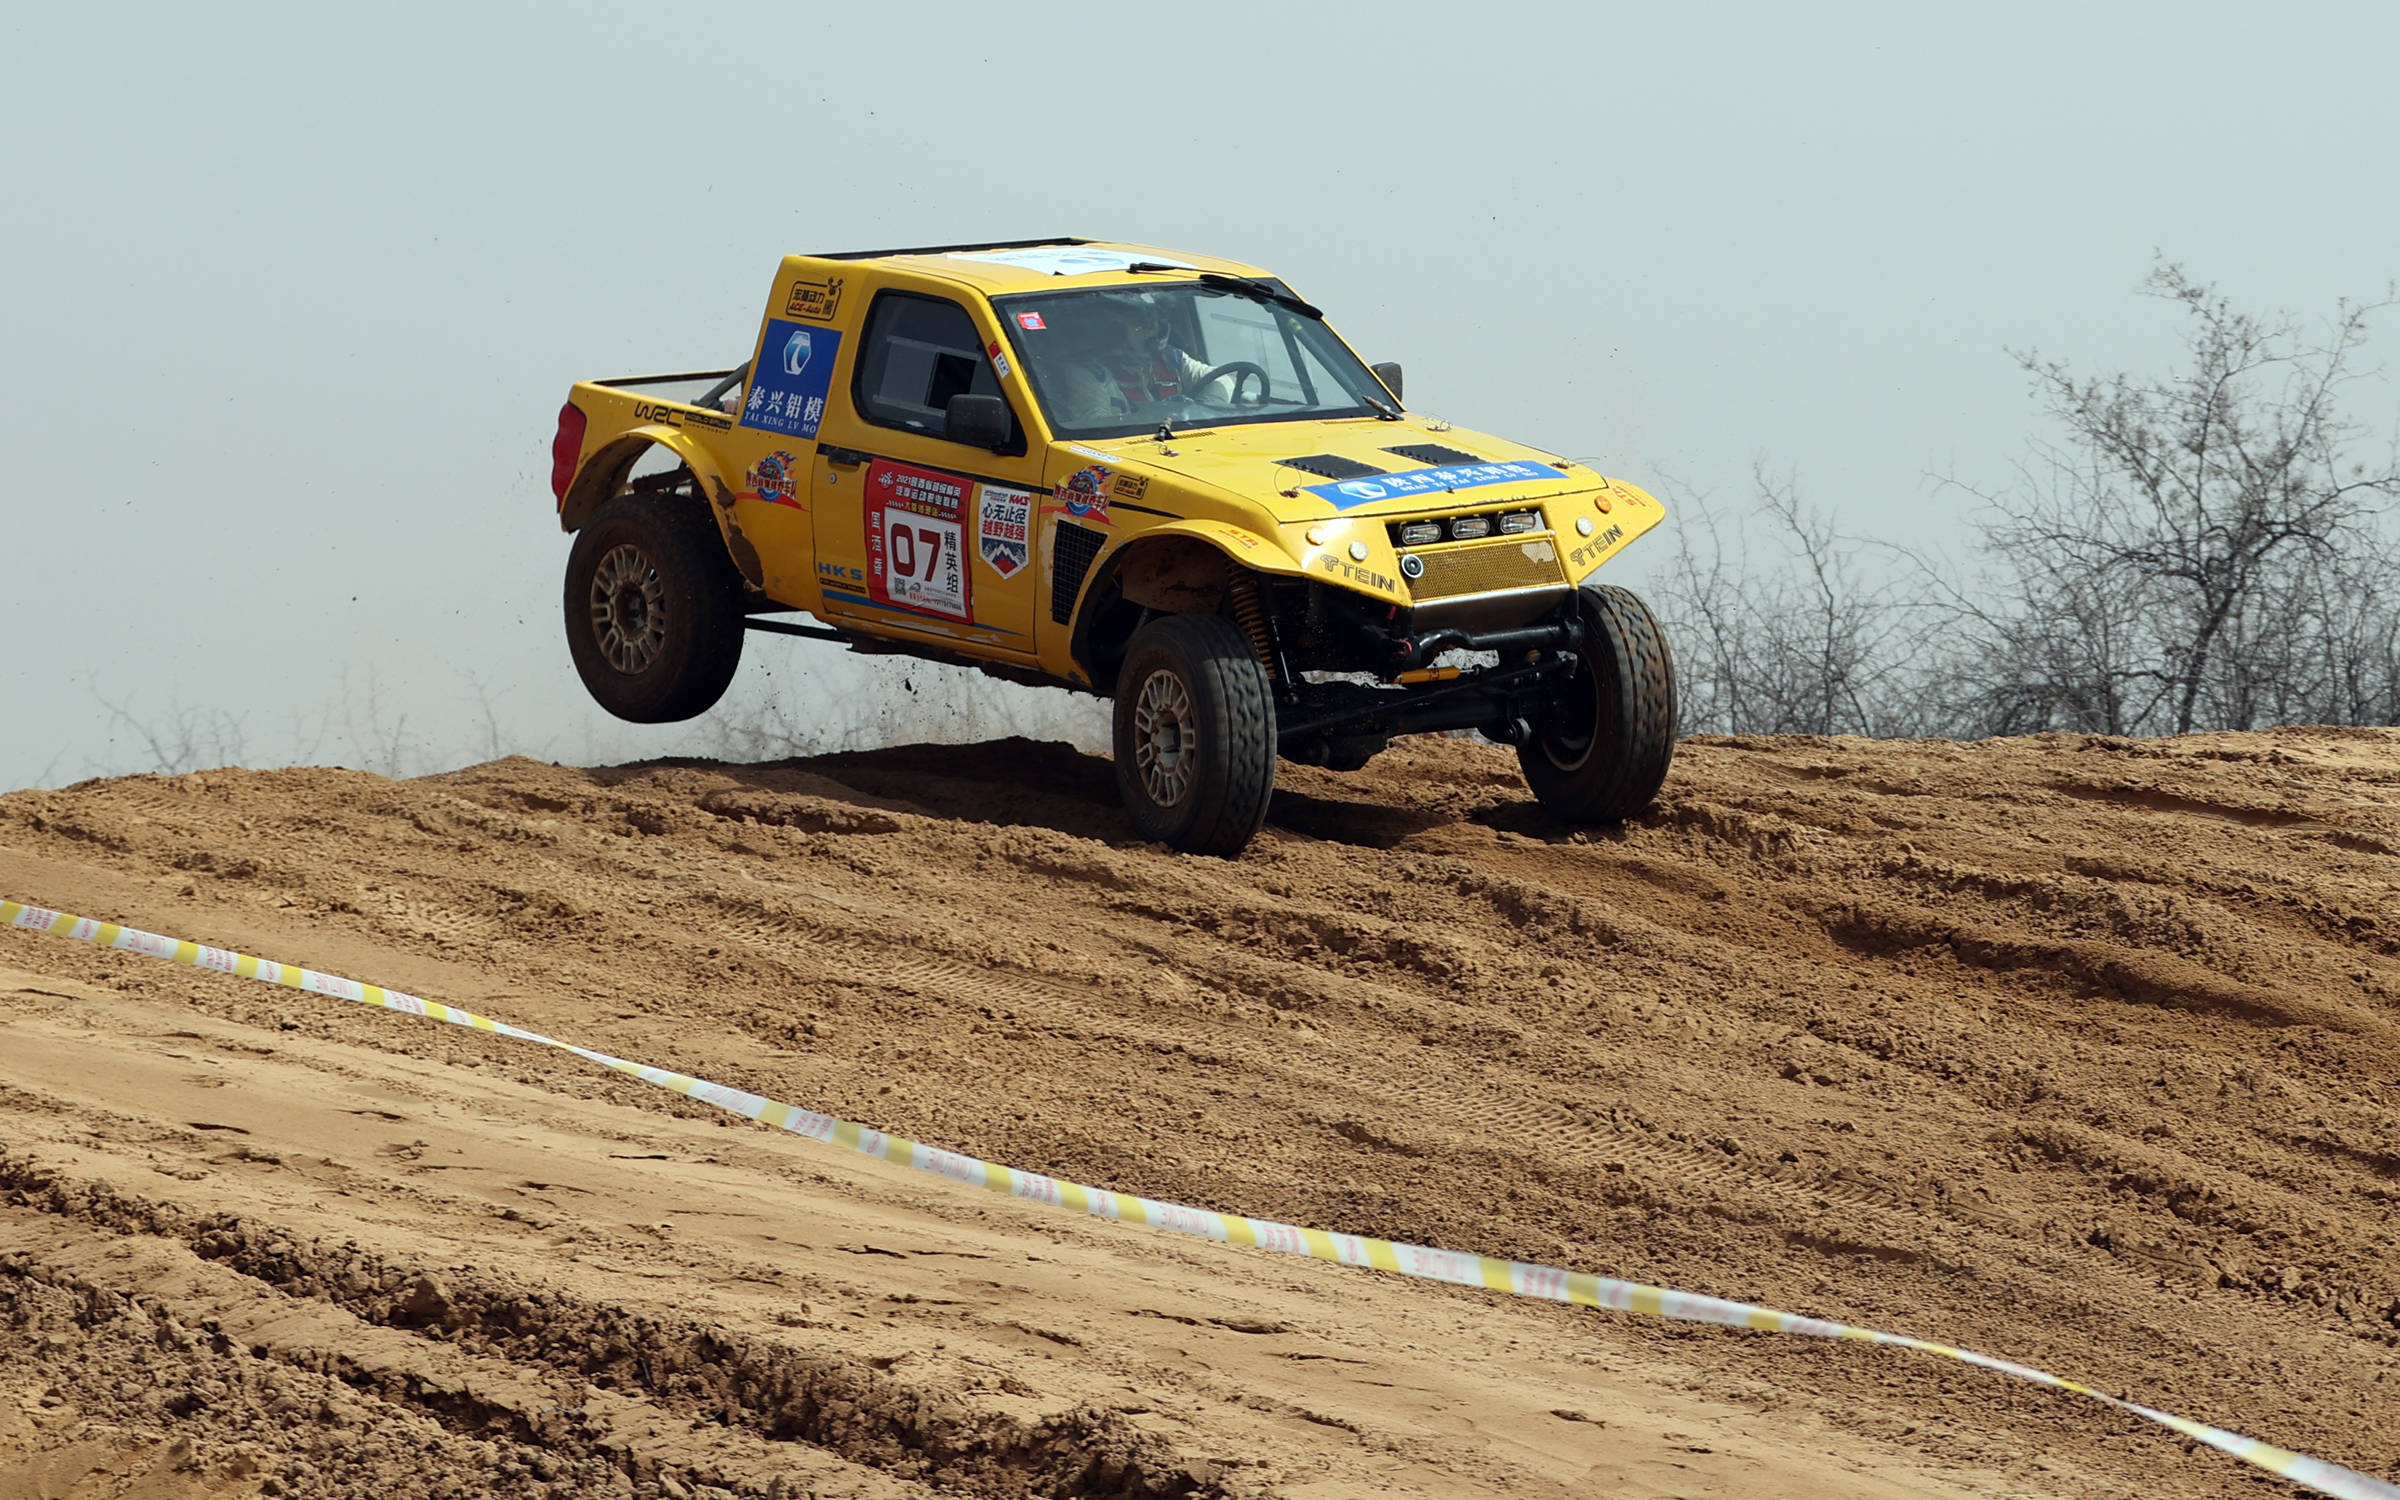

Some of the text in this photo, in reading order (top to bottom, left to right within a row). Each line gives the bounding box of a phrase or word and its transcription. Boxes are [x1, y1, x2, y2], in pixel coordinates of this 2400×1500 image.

[634, 401, 685, 428] WRC
[747, 386, 824, 423] 泰兴铝模
[744, 411, 817, 434] TAI XING LV MO
[982, 502, 1027, 525] 心无止径
[982, 519, 1026, 541] 越野越强
[1583, 523, 1624, 559] TEIN
[891, 522, 941, 582] 07
[943, 530, 959, 594] 精英组
[818, 561, 863, 581] HKS
[1337, 560, 1396, 593] TEIN
